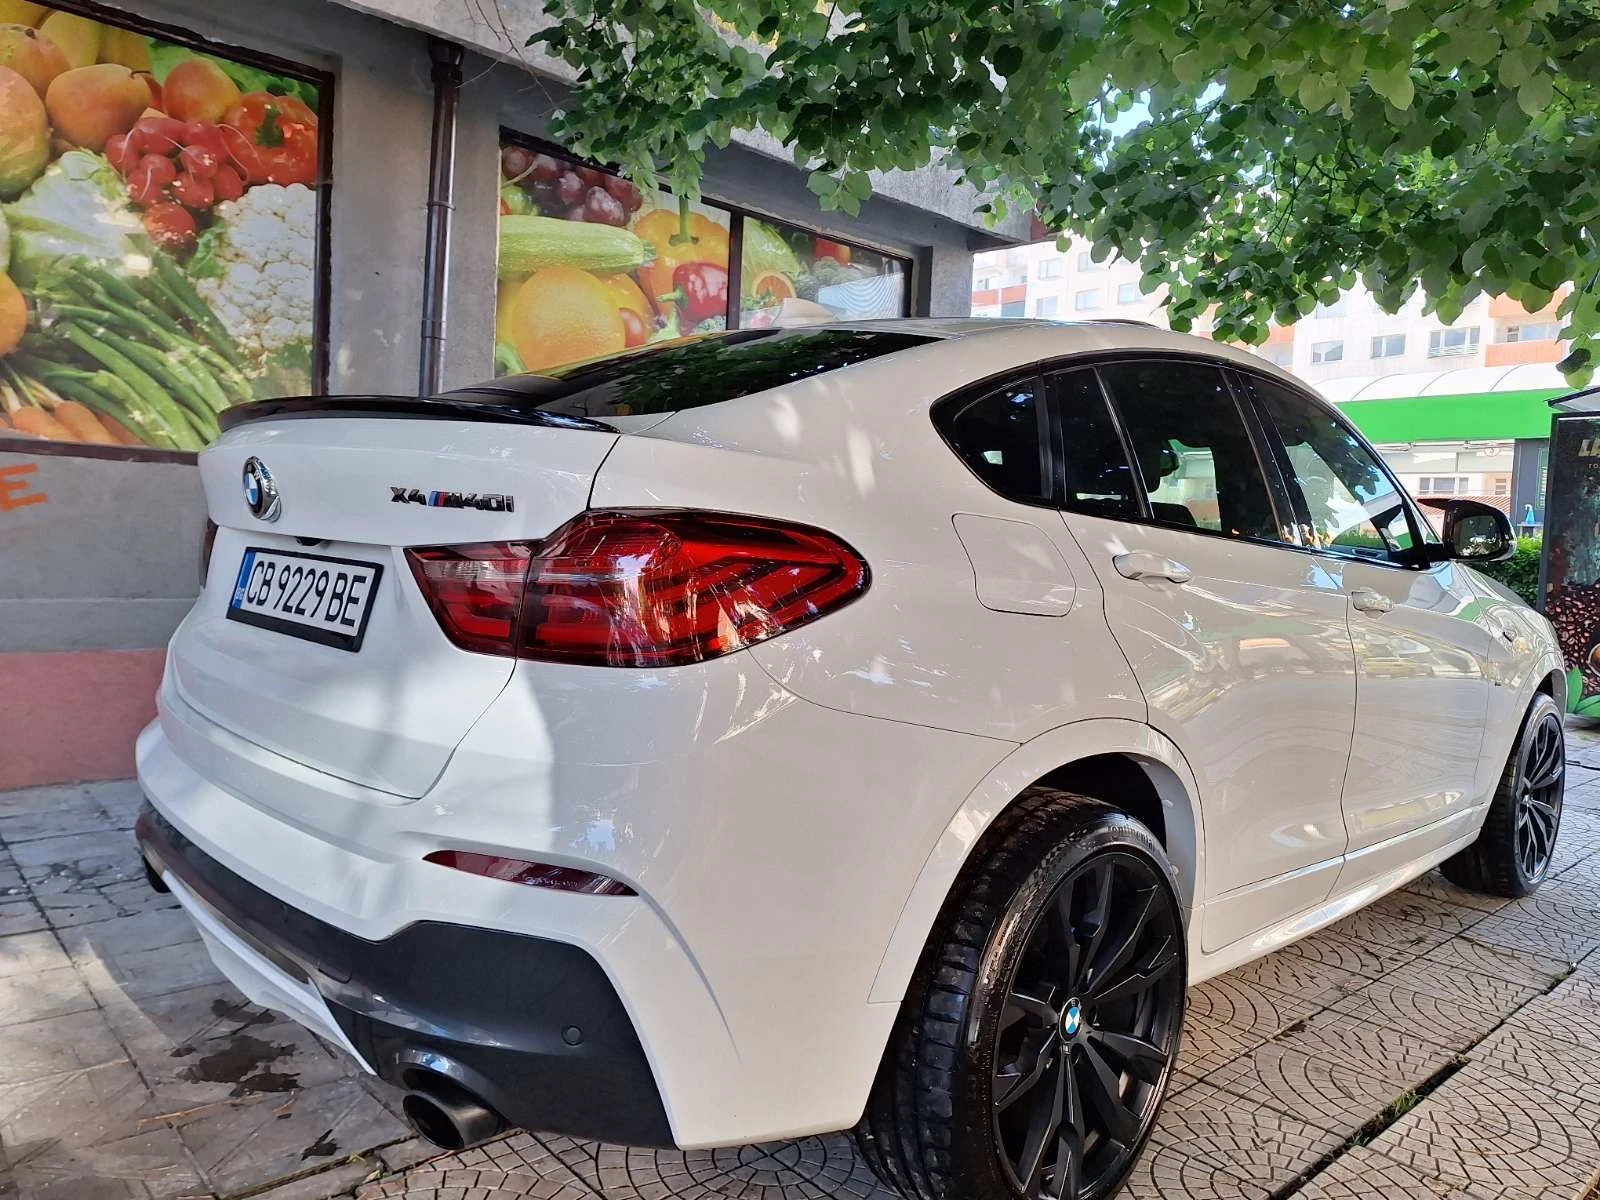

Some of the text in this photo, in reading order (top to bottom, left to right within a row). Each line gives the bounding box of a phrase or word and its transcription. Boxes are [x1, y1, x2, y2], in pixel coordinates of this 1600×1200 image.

[390, 486, 427, 505] X4
[246, 560, 368, 627] CB 9229 BE
